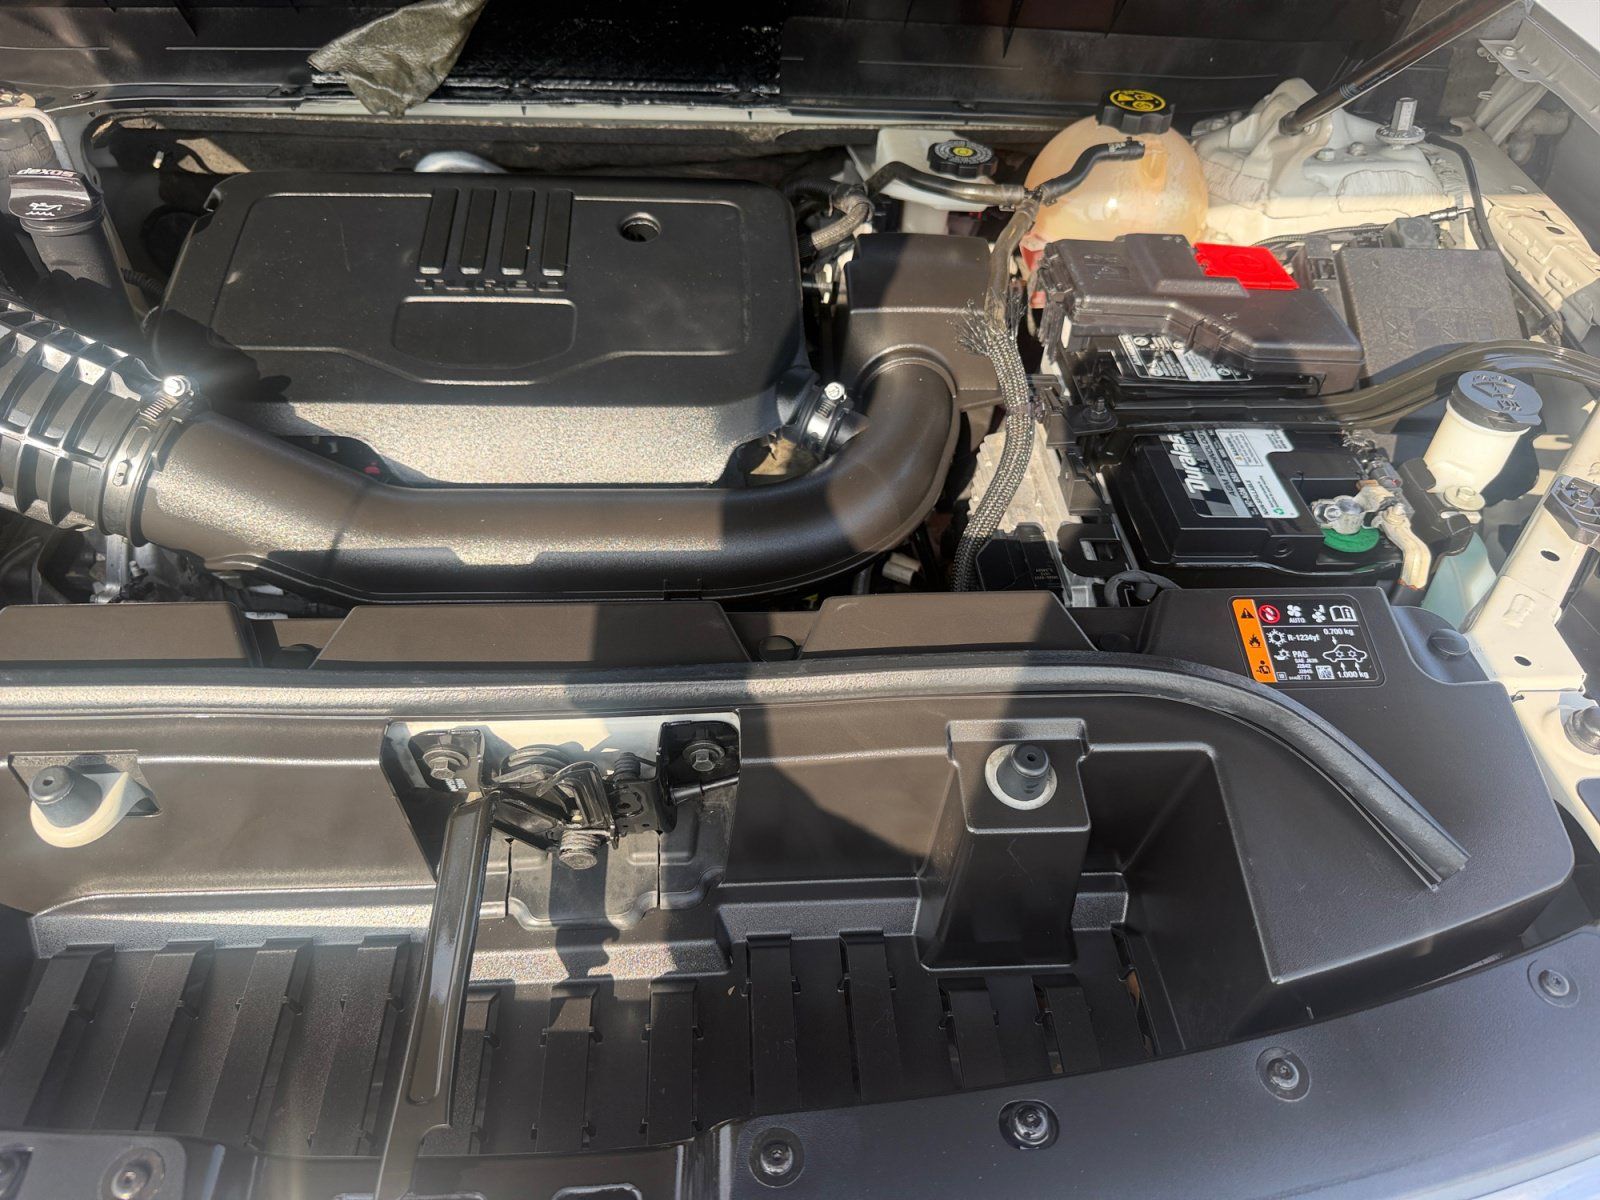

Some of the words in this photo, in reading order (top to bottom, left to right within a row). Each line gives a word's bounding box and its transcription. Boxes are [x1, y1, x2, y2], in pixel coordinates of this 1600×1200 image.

[17, 167, 78, 177] dexos
[1167, 433, 1212, 494] Duralas
[1221, 478, 1237, 497] AGM
[1344, 628, 1354, 636] kg
[1292, 650, 1309, 658] PAG
[1359, 671, 1369, 679] kg
